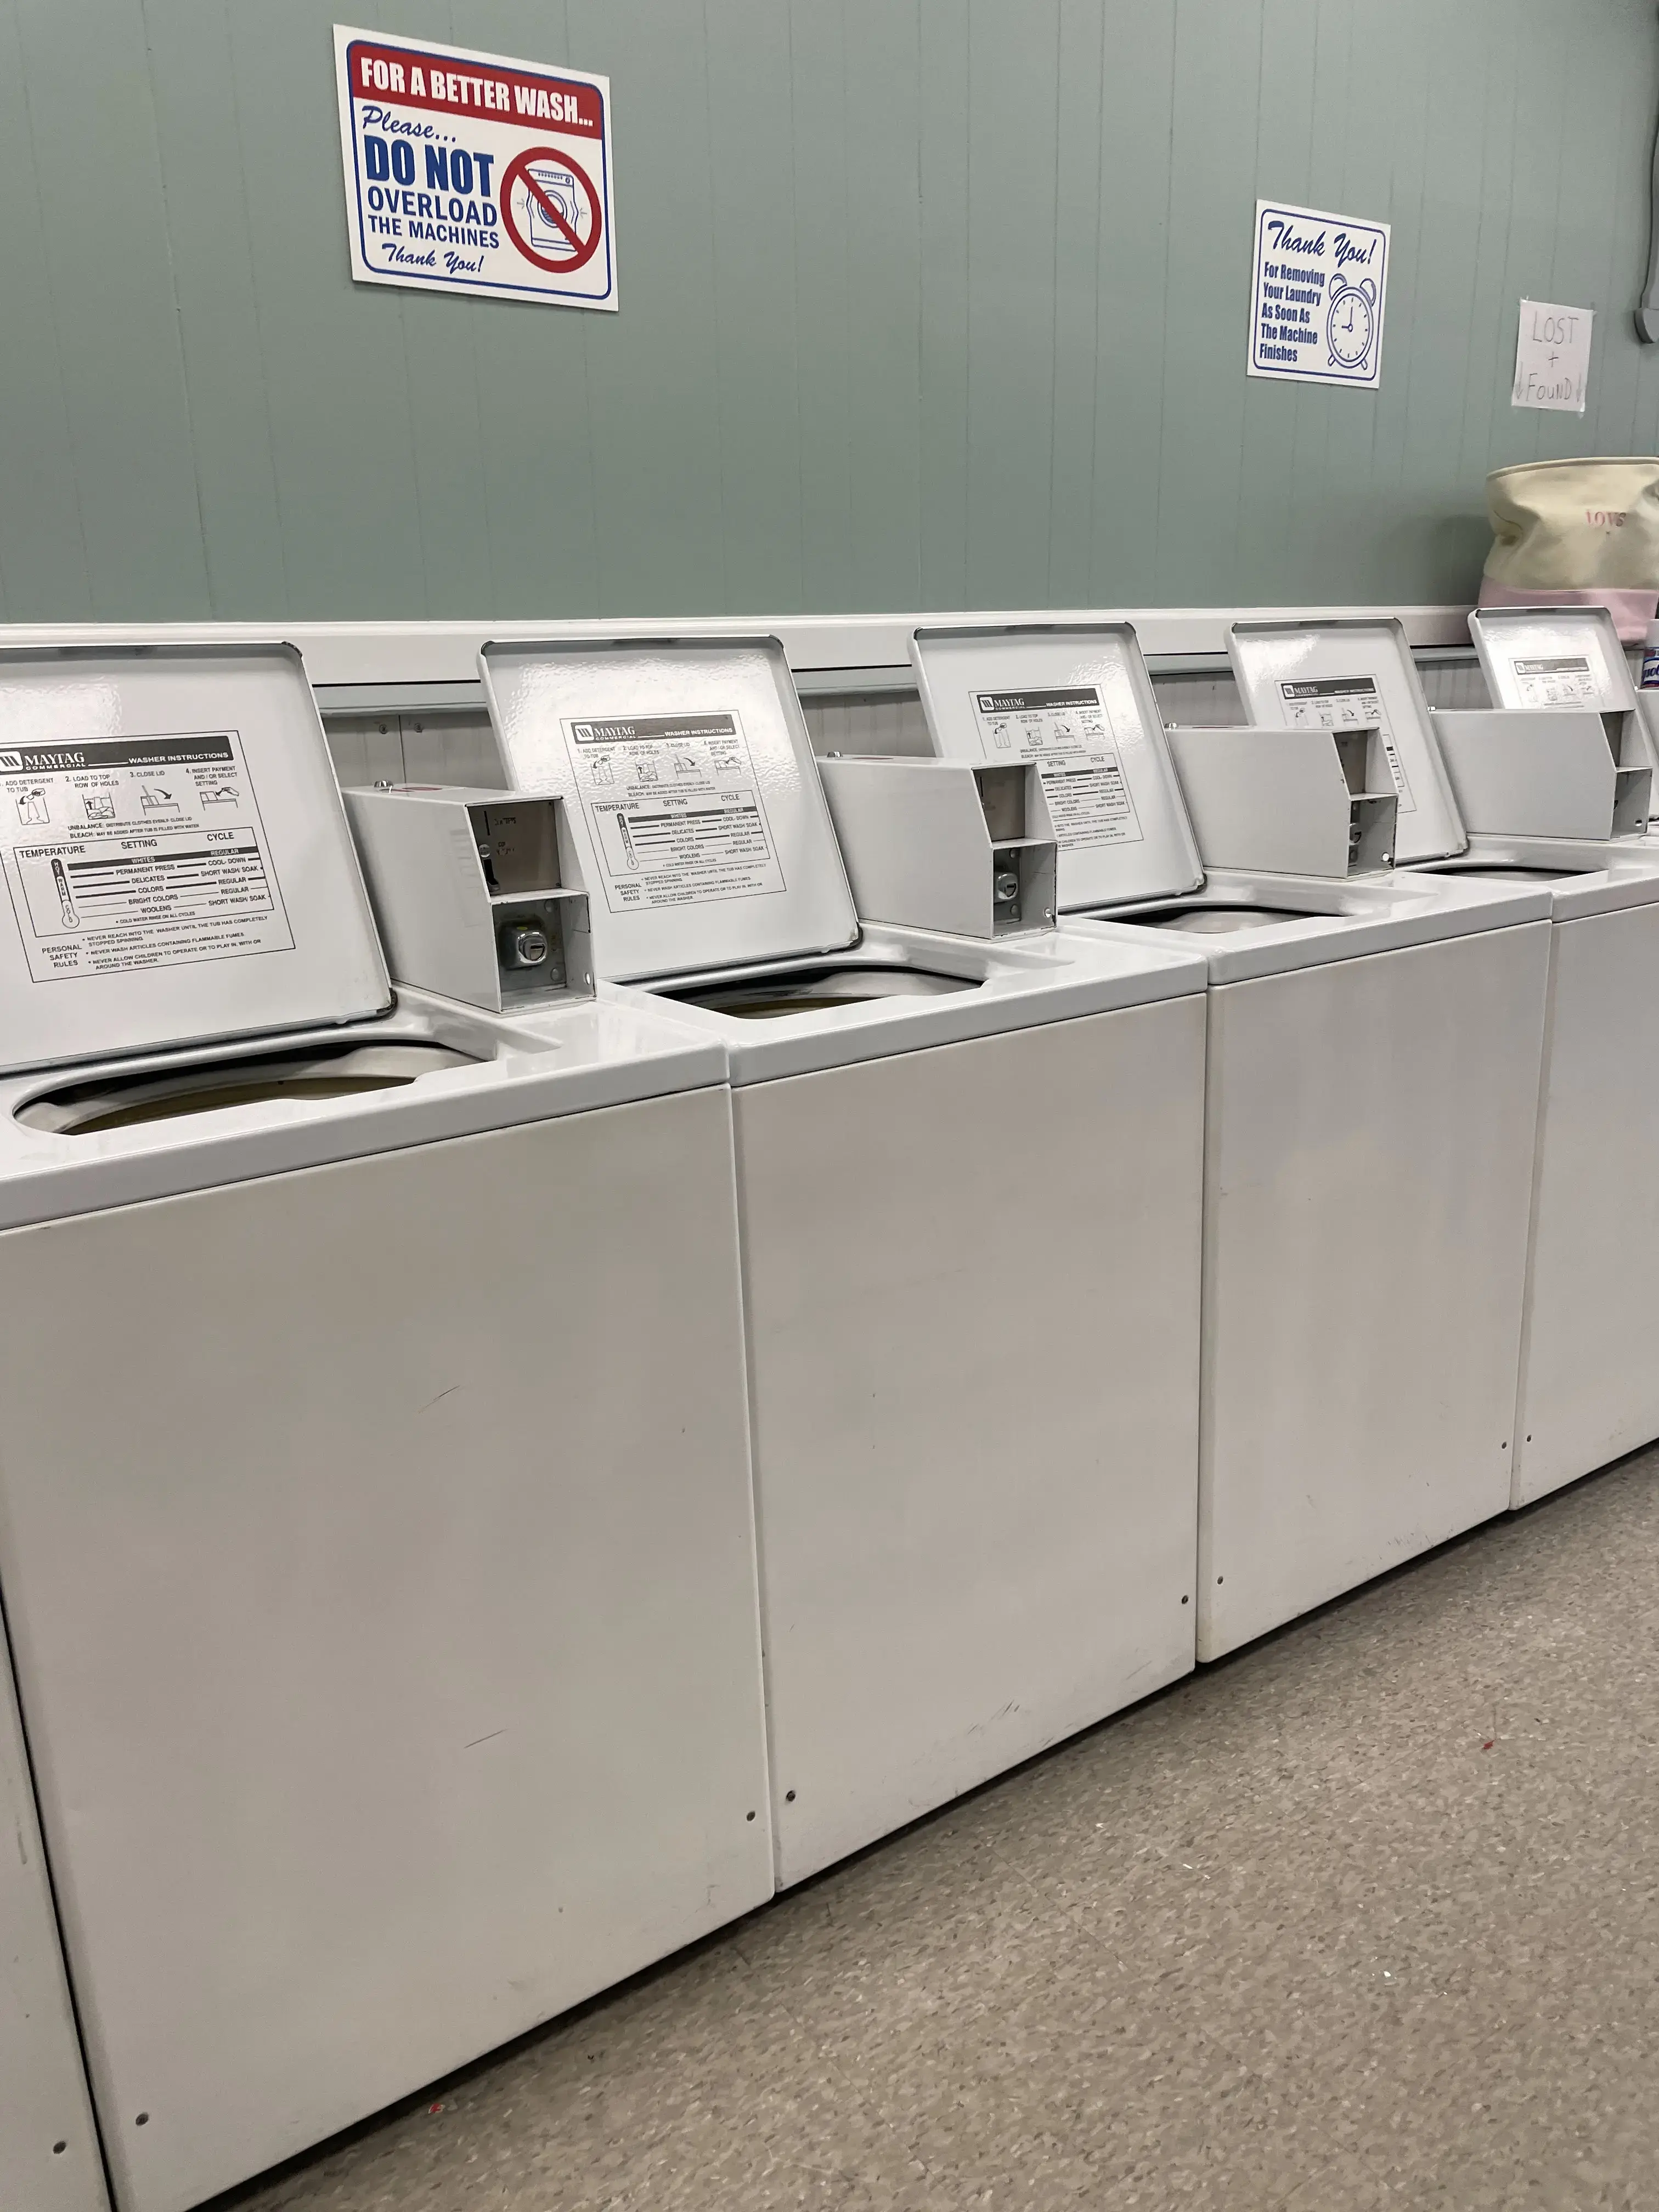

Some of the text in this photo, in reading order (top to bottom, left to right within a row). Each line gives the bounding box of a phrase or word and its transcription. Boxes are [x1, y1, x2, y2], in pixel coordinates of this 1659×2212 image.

[360, 57, 594, 127] FOR A BETTER WASH...
[362, 105, 456, 142] Please...
[364, 134, 494, 198] DO NOT
[368, 186, 498, 227] OVERLOAD
[368, 215, 499, 249] THE MACHINES
[1268, 221, 1377, 268] Thank You!
[382, 243, 485, 274] Thank You!
[1264, 261, 1325, 287] For Removing
[1263, 282, 1322, 307] Your Laundry
[1262, 303, 1311, 324] As Soon As
[1261, 323, 1318, 345] The Machine
[1533, 311, 1579, 345] LOST
[1260, 343, 1298, 362] Finishes
[1548, 351, 1559, 368] +
[994, 698, 1025, 707] MAYTAG
[593, 726, 635, 736] MAYTAG
[23, 752, 85, 766] MAYTAG
[167, 752, 228, 761] INSTRUCTIONS
[595, 802, 640, 812] TEMPERATURE
[120, 838, 157, 849] SETTING
[206, 832, 234, 841] CYCLE
[19, 845, 86, 859] TEMPERATURE
[115, 866, 154, 875] PERMANENT
[131, 875, 165, 883] DELICATES
[140, 905, 172, 913] WOOLENS
[41, 944, 82, 953] PERSONAL
[157, 939, 190, 947] CONTAINING
[49, 952, 78, 961] SAFETY
